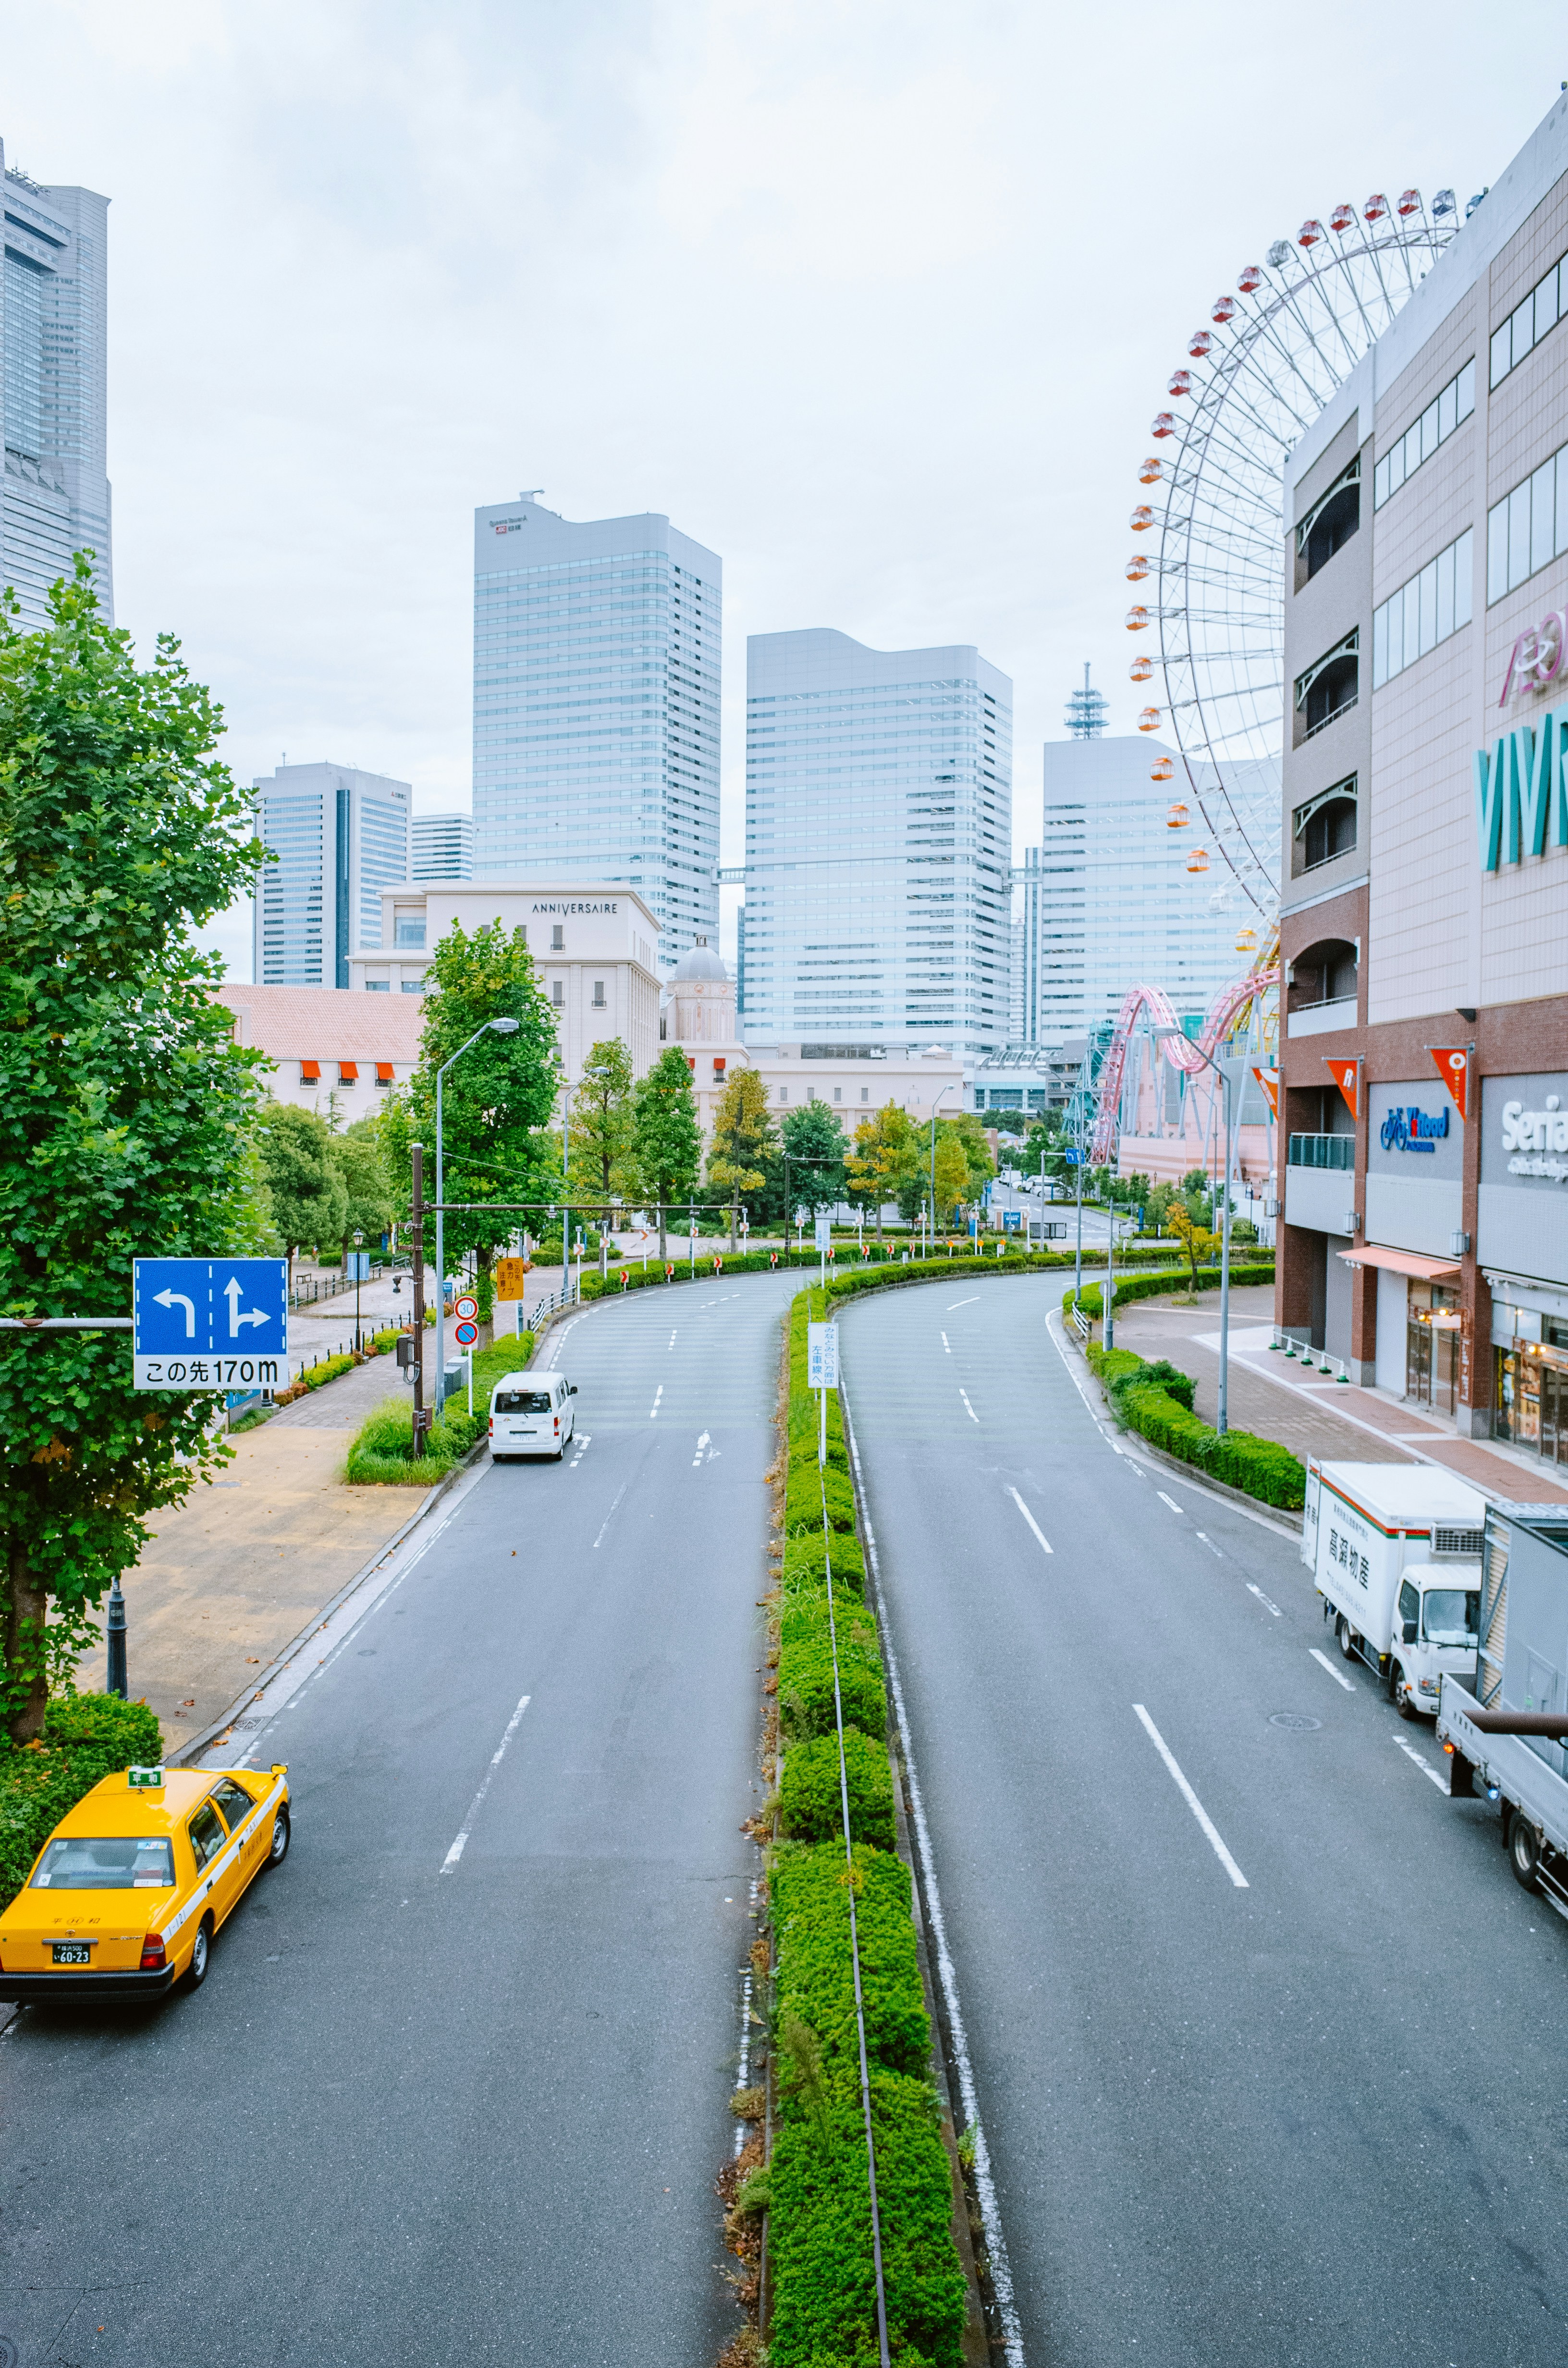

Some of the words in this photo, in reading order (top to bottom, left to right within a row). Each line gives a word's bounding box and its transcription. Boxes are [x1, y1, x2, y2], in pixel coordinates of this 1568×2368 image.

[532, 903, 618, 917] ANNIVERSAIRE
[460, 1303, 473, 1315] 30
[812, 1344, 823, 1384] 左車線へ
[824, 1326, 835, 1384] みなとみらい方面は
